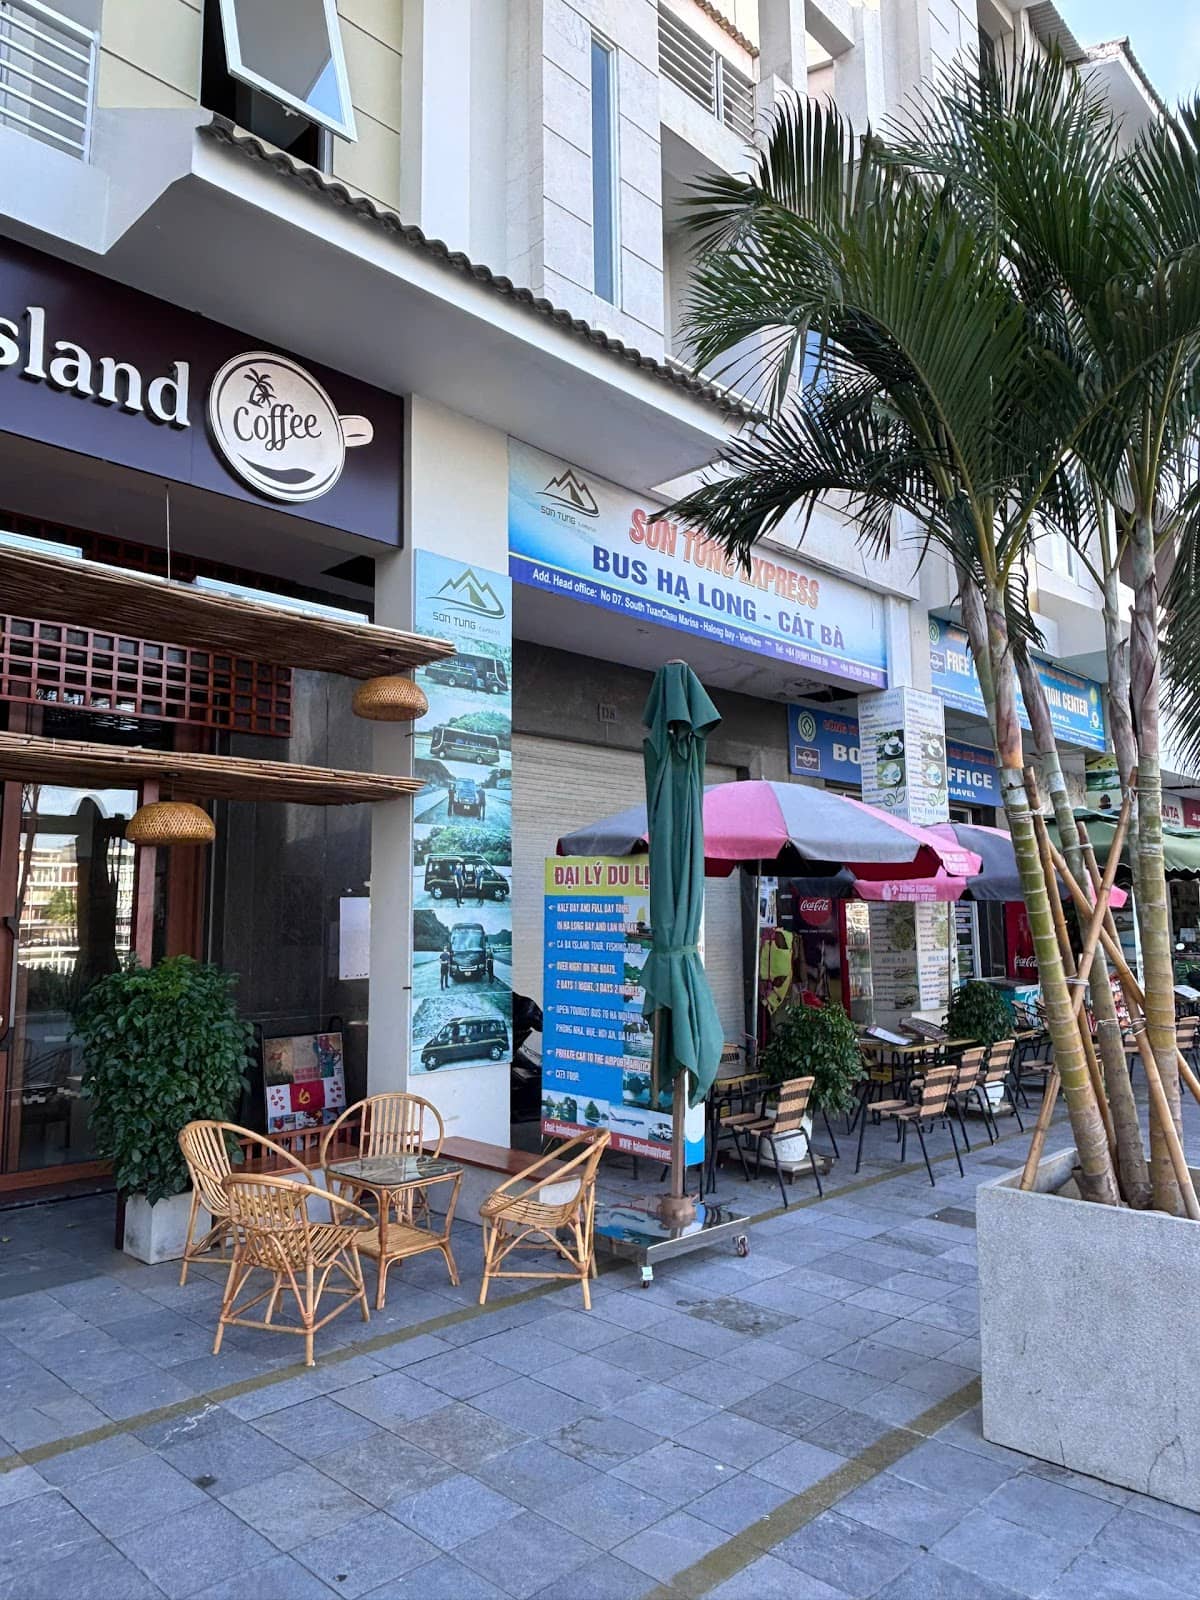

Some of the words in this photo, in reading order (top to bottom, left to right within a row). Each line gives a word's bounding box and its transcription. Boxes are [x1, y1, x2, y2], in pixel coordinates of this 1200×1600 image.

[233, 403, 322, 452] Coffee
[533, 568, 551, 584] Add.
[553, 574, 573, 590] Head
[574, 581, 597, 598] office:
[600, 589, 611, 601] No
[624, 597, 645, 613] South
[678, 613, 700, 630] Marina
[703, 621, 725, 639] Halong
[593, 545, 648, 585] BUS
[658, 568, 691, 604] HẠ
[698, 582, 757, 622] LONG
[778, 611, 815, 641] CÁT
[820, 624, 845, 650] BÀ
[739, 554, 820, 609] EXPRESS
[946, 649, 971, 677] FREE
[1062, 692, 1089, 717] CENTER
[832, 743, 861, 765] BO
[947, 766, 993, 790] FFICE
[554, 866, 581, 889] ĐẠI
[584, 861, 603, 885] LÝ
[607, 865, 630, 885] DU
[635, 866, 649, 889] LỊ
